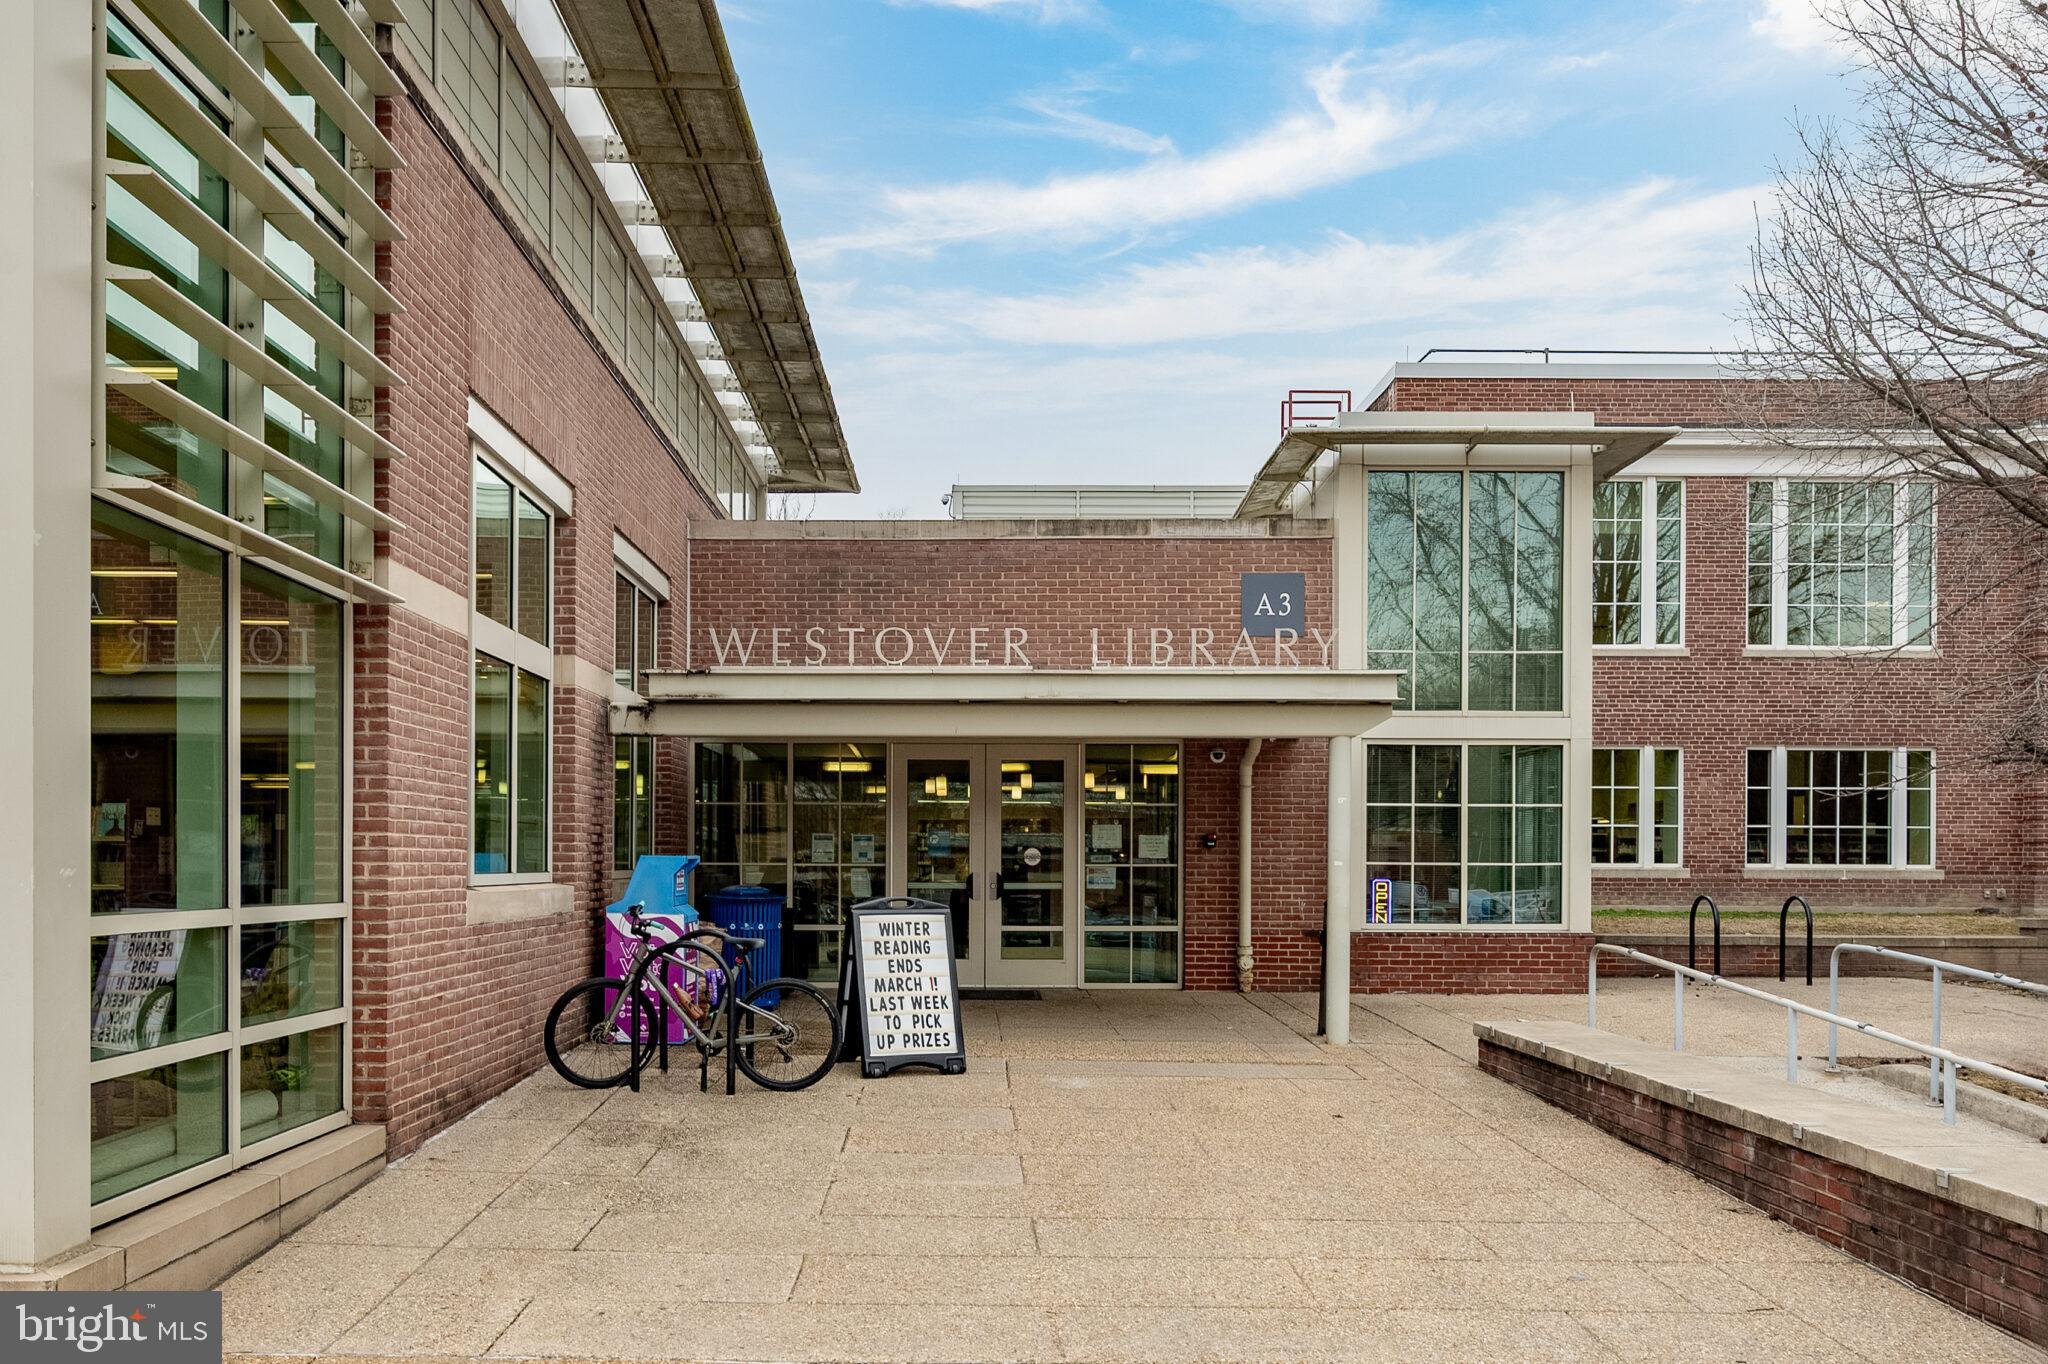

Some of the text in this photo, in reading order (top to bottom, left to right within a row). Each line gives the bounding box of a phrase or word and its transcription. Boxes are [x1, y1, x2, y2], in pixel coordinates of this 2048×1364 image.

[1253, 592, 1292, 616] A3
[708, 626, 1340, 667] WESTOVER LIBRARY
[1375, 882, 1388, 923] OPEN
[879, 922, 931, 936] WINTER
[874, 940, 931, 955] READING
[888, 959, 923, 973] ENDS
[874, 976, 938, 992] MARCH 1!
[870, 995, 949, 1012] LAST WEEK
[884, 1014, 942, 1030] TO PICK
[876, 1032, 951, 1049] UP PRIZES
